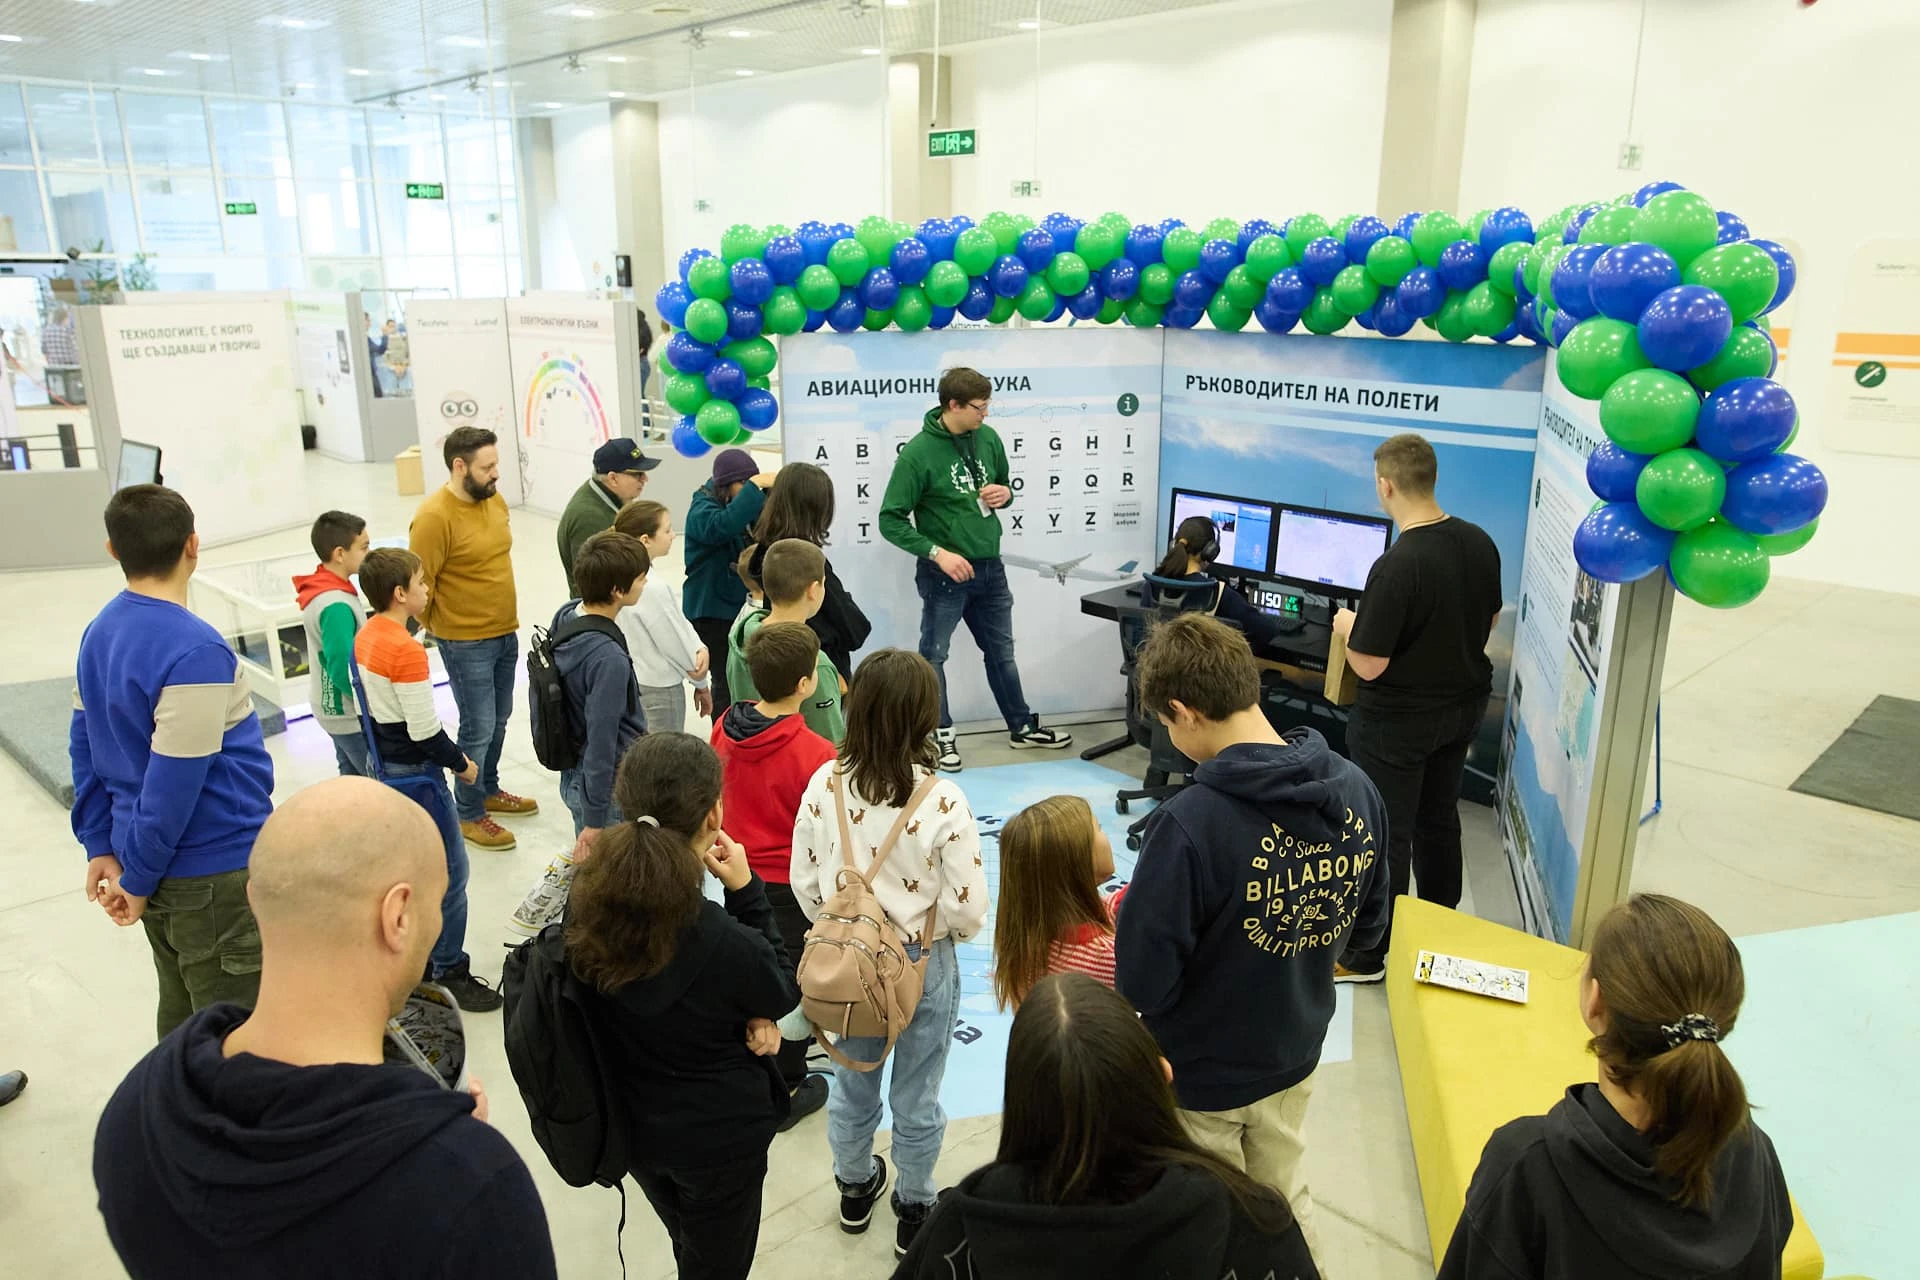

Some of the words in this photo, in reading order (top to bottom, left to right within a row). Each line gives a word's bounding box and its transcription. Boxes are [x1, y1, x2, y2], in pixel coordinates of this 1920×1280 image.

[211, 325, 217, 336] С
[220, 324, 254, 336] КОИТО
[122, 346, 140, 360] ЩЕ
[144, 343, 206, 357] СЪЗДАВАШ
[209, 343, 217, 352] И
[220, 339, 261, 352] ТВОРИШ
[807, 378, 940, 398] АВИАЦИОНН
[1185, 374, 1318, 401] РЪКОВОДИТЕЛ
[1324, 386, 1350, 404] НА
[1357, 389, 1440, 412] ПОЛЕТИ
[815, 445, 829, 460] A
[856, 443, 869, 458] B
[1013, 438, 1024, 453] F
[1049, 437, 1062, 451] G
[1086, 435, 1098, 450] H
[1126, 434, 1131, 448] I
[857, 483, 870, 498] K
[1011, 477, 1024, 491] O
[1049, 475, 1060, 489] P
[1085, 474, 1098, 488] Q
[1122, 472, 1133, 486] R
[858, 523, 870, 537] T
[1012, 515, 1023, 529] X
[1048, 513, 1060, 527] Y
[1085, 511, 1096, 525] Z
[1295, 841, 1333, 859] Since
[1246, 849, 1375, 902] BILLABONG
[1277, 888, 1346, 933] TRADEMARK
